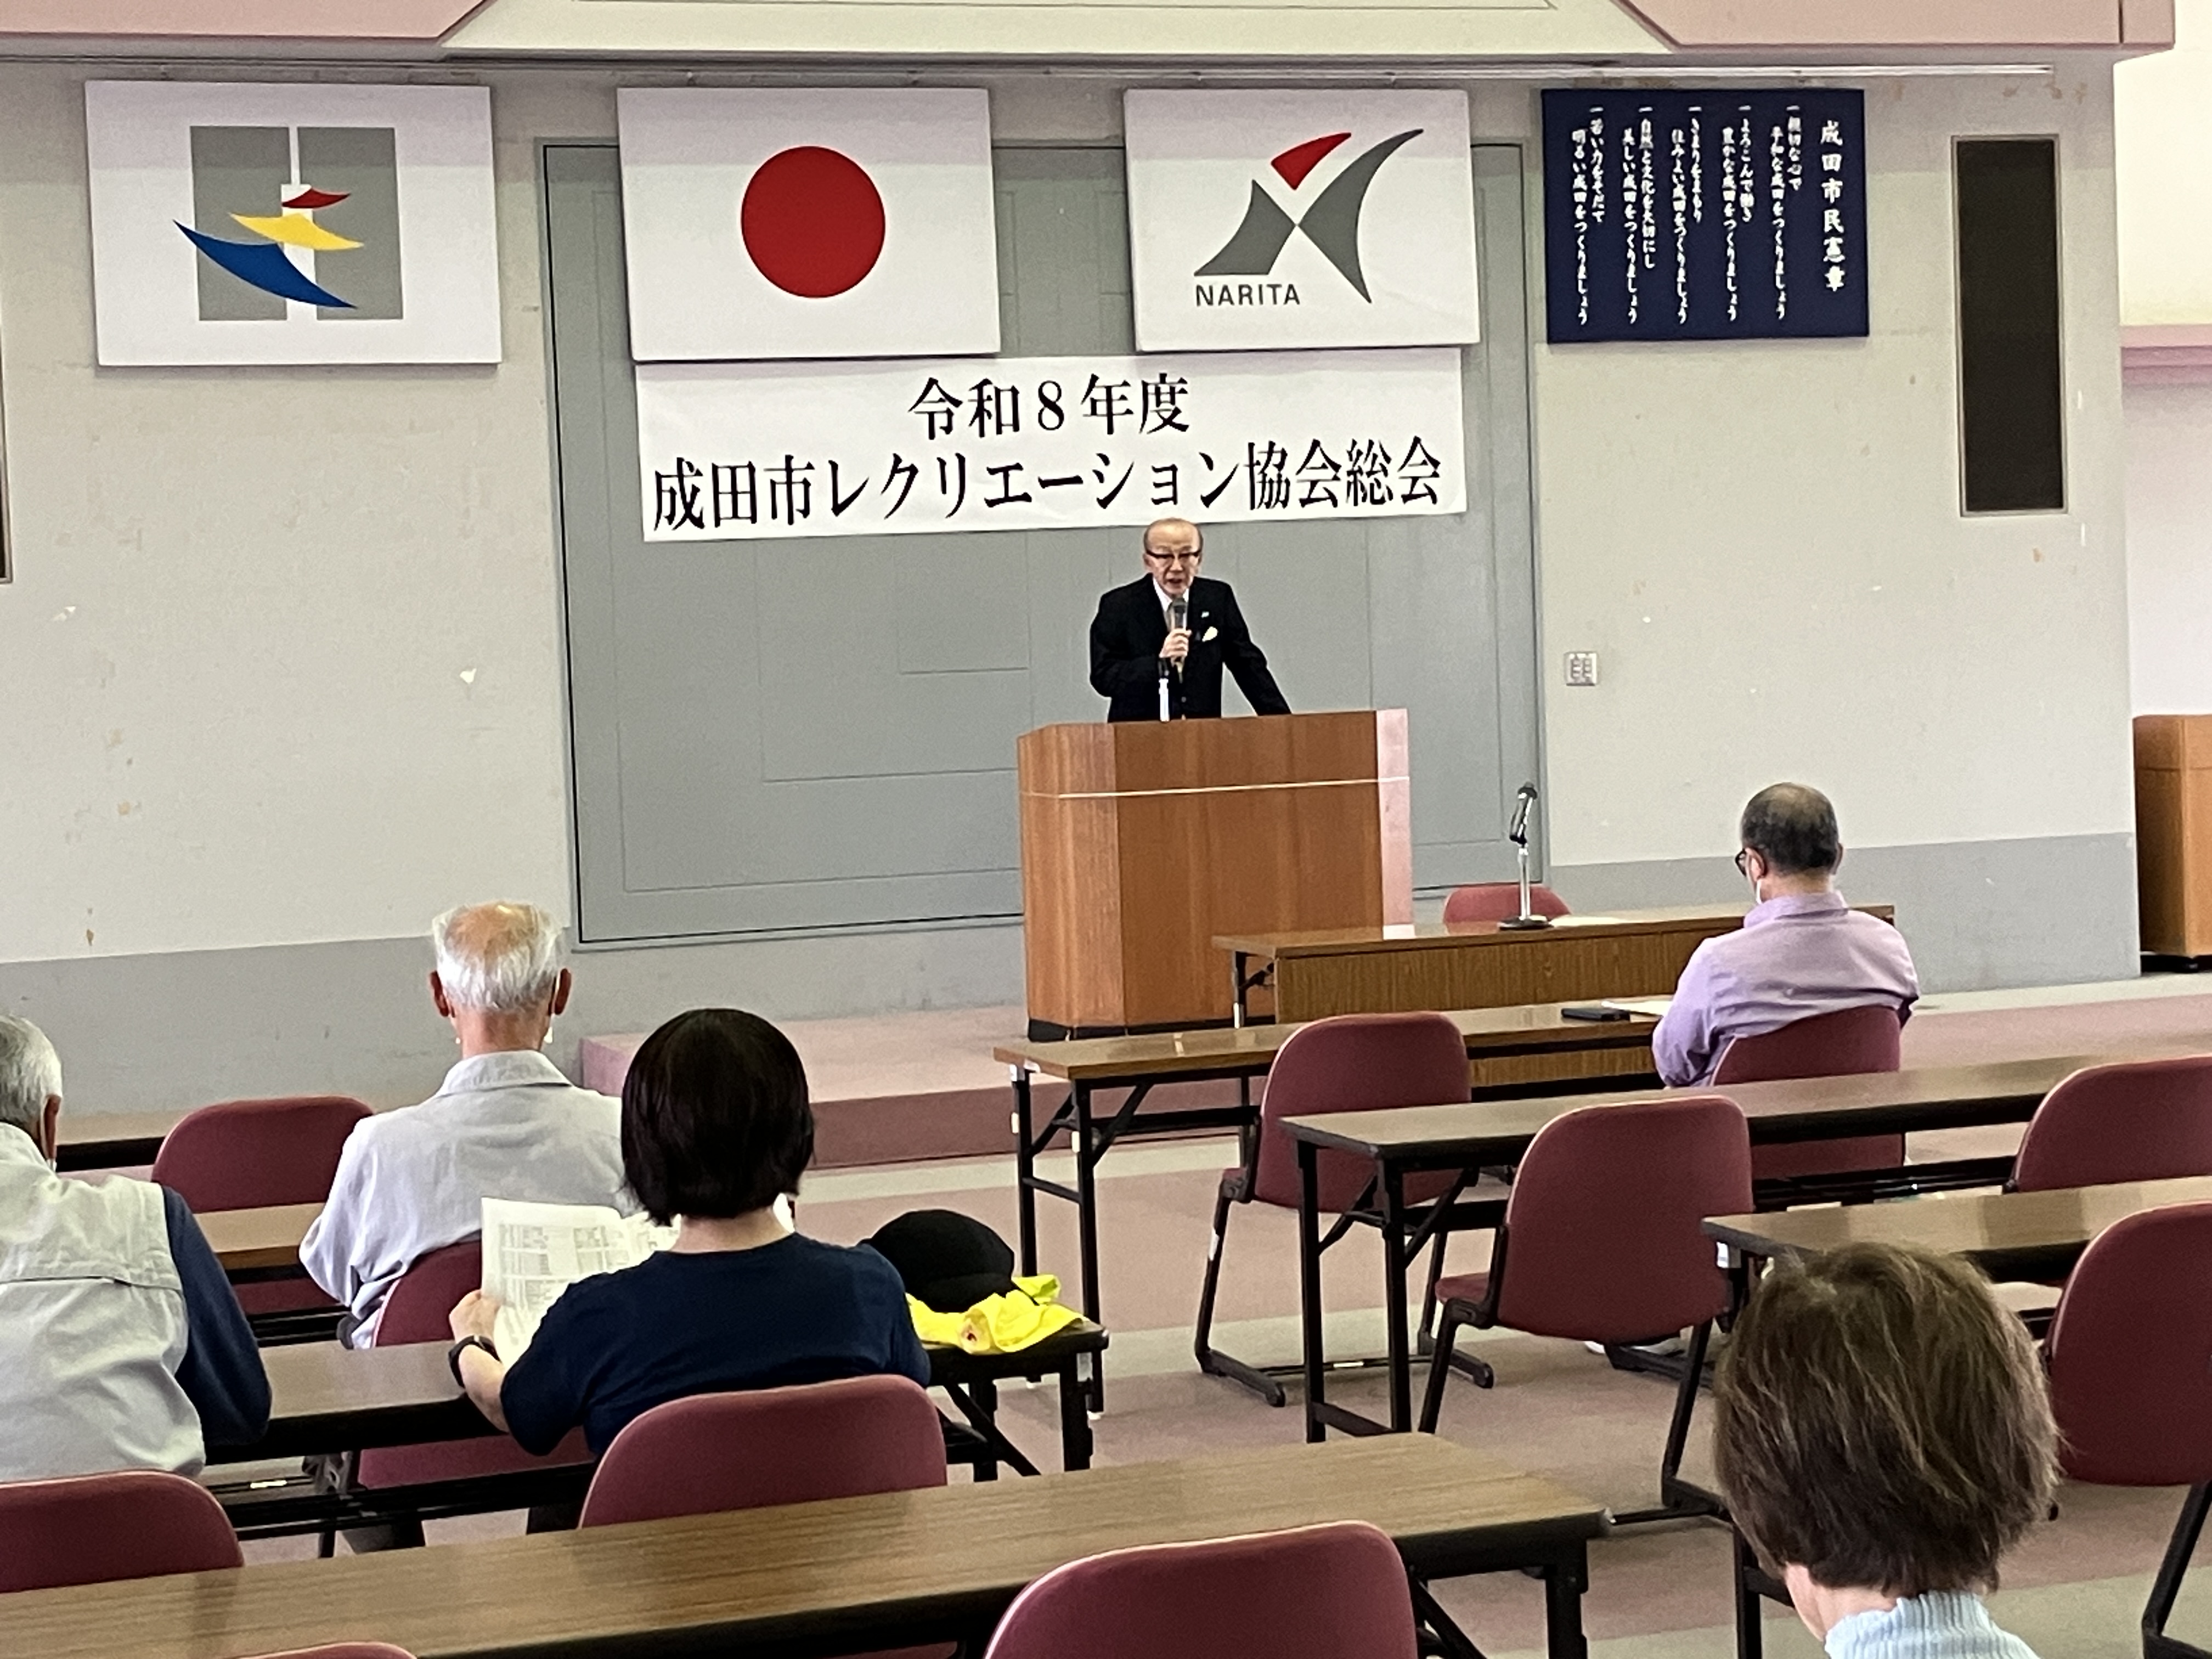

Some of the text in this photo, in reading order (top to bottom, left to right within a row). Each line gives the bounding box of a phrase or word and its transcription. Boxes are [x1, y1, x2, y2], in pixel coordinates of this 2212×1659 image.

[1820, 120, 1846, 292] 成田市民憲章
[1196, 284, 1300, 306] NARITA
[908, 373, 1189, 441] 令和8年度
[653, 435, 1442, 532] 成田市レクリエーション協会総会
